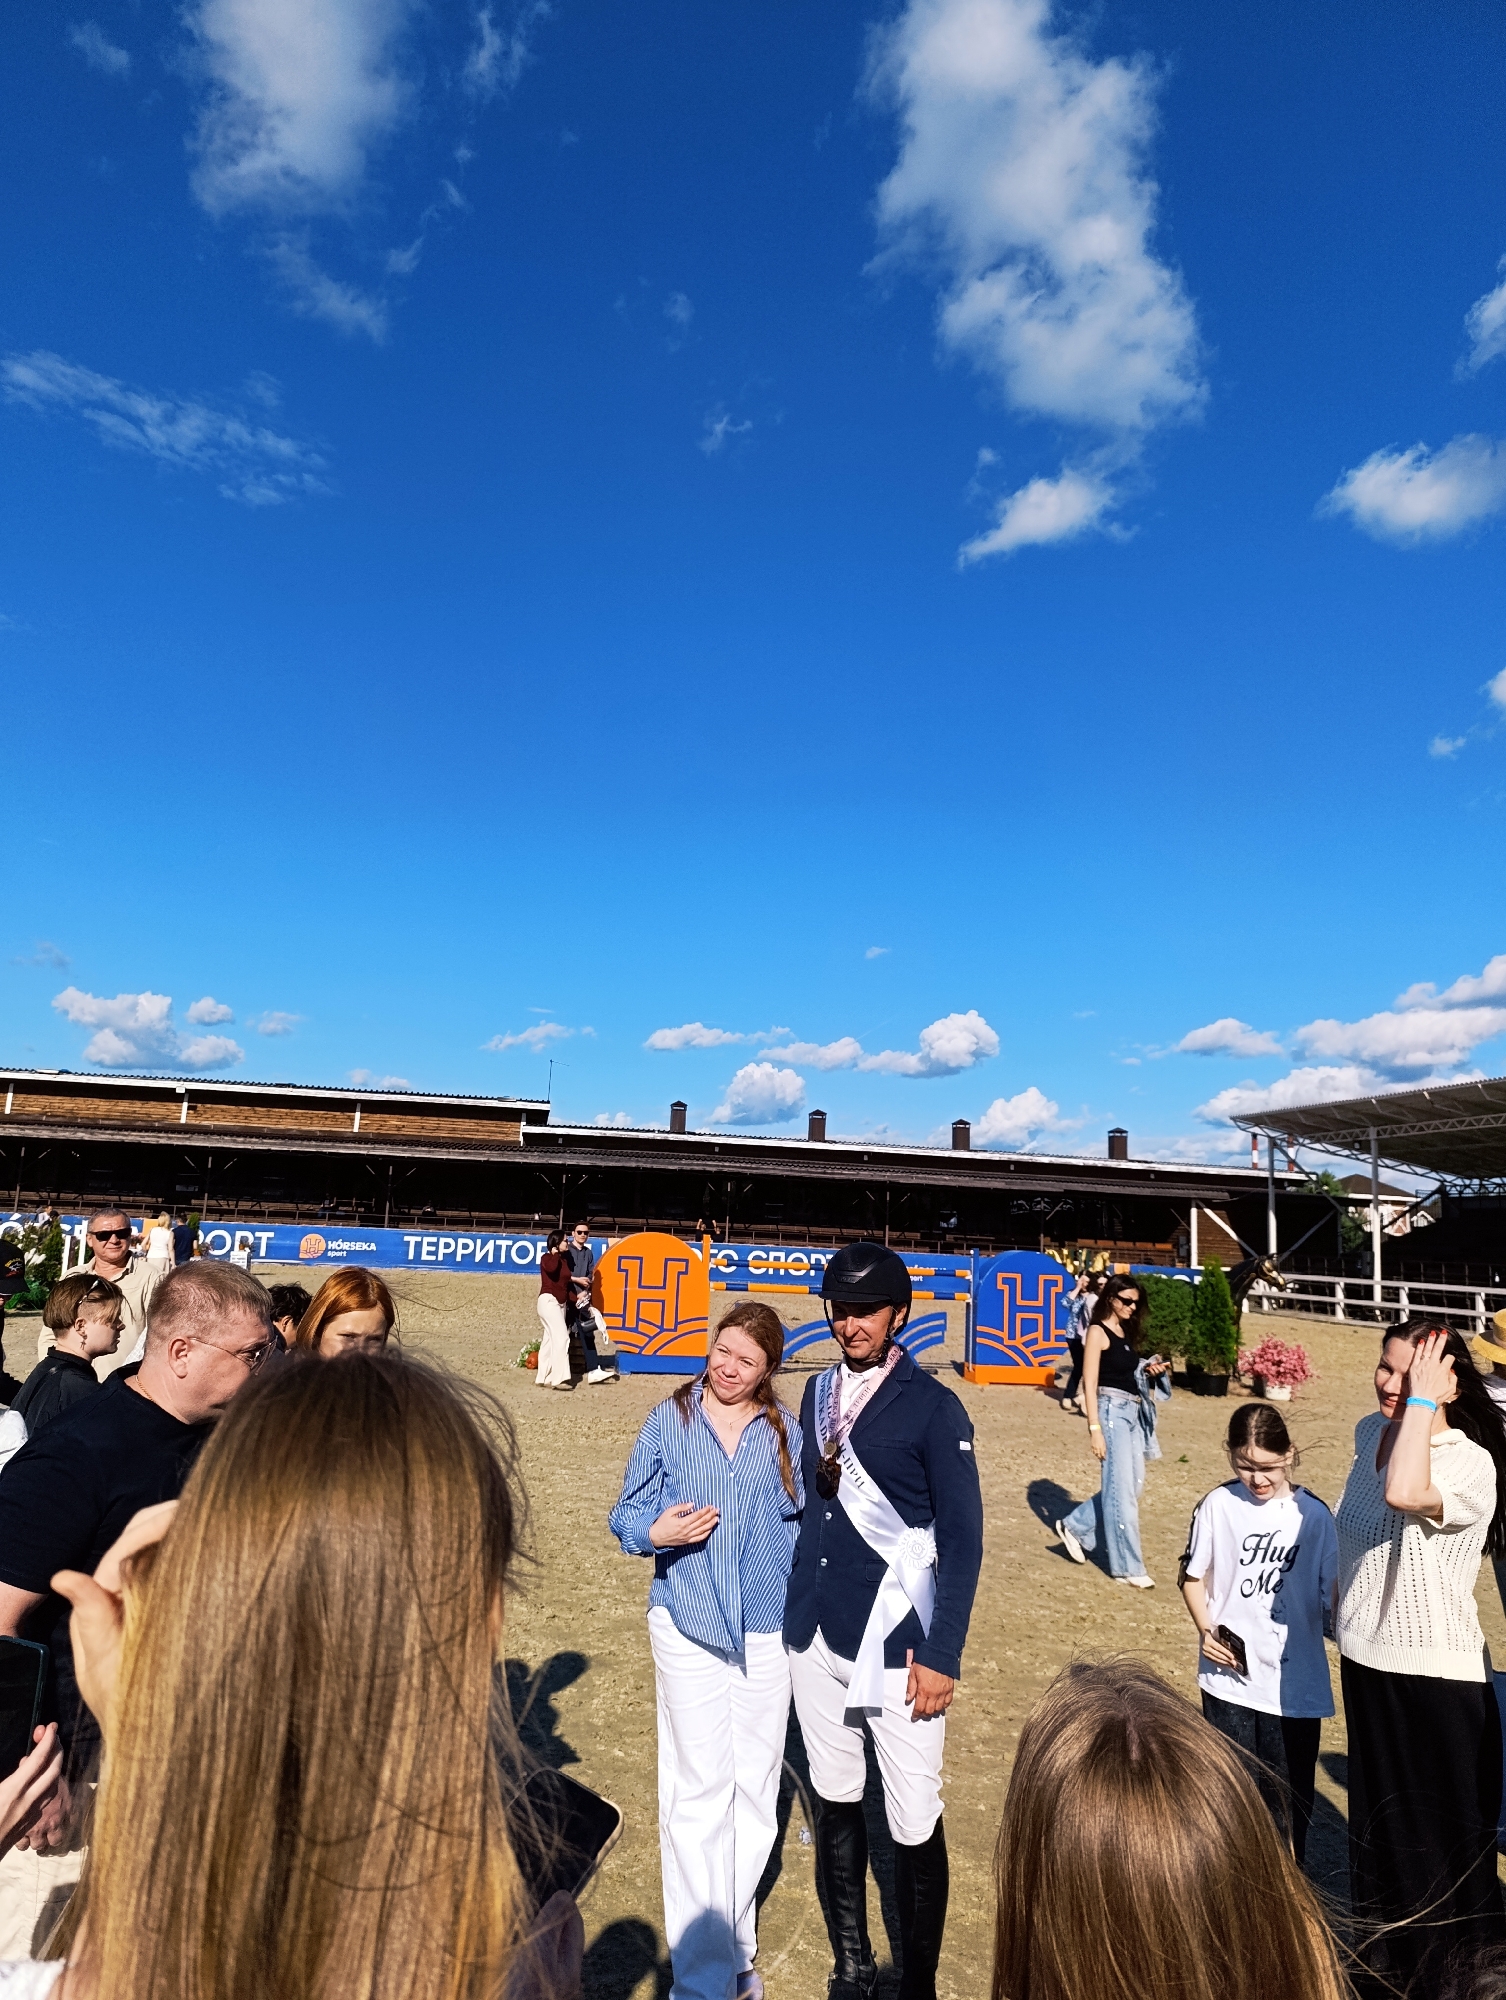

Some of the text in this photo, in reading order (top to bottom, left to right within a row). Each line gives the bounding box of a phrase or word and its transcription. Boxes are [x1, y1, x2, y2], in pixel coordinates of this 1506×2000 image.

[198, 1229, 275, 1257] ORT
[327, 1239, 377, 1251] HÓRSEKA
[403, 1235, 592, 1265] ТЕРРИТОР
[1239, 1530, 1301, 1572] Hug
[1240, 1567, 1284, 1598] Me
